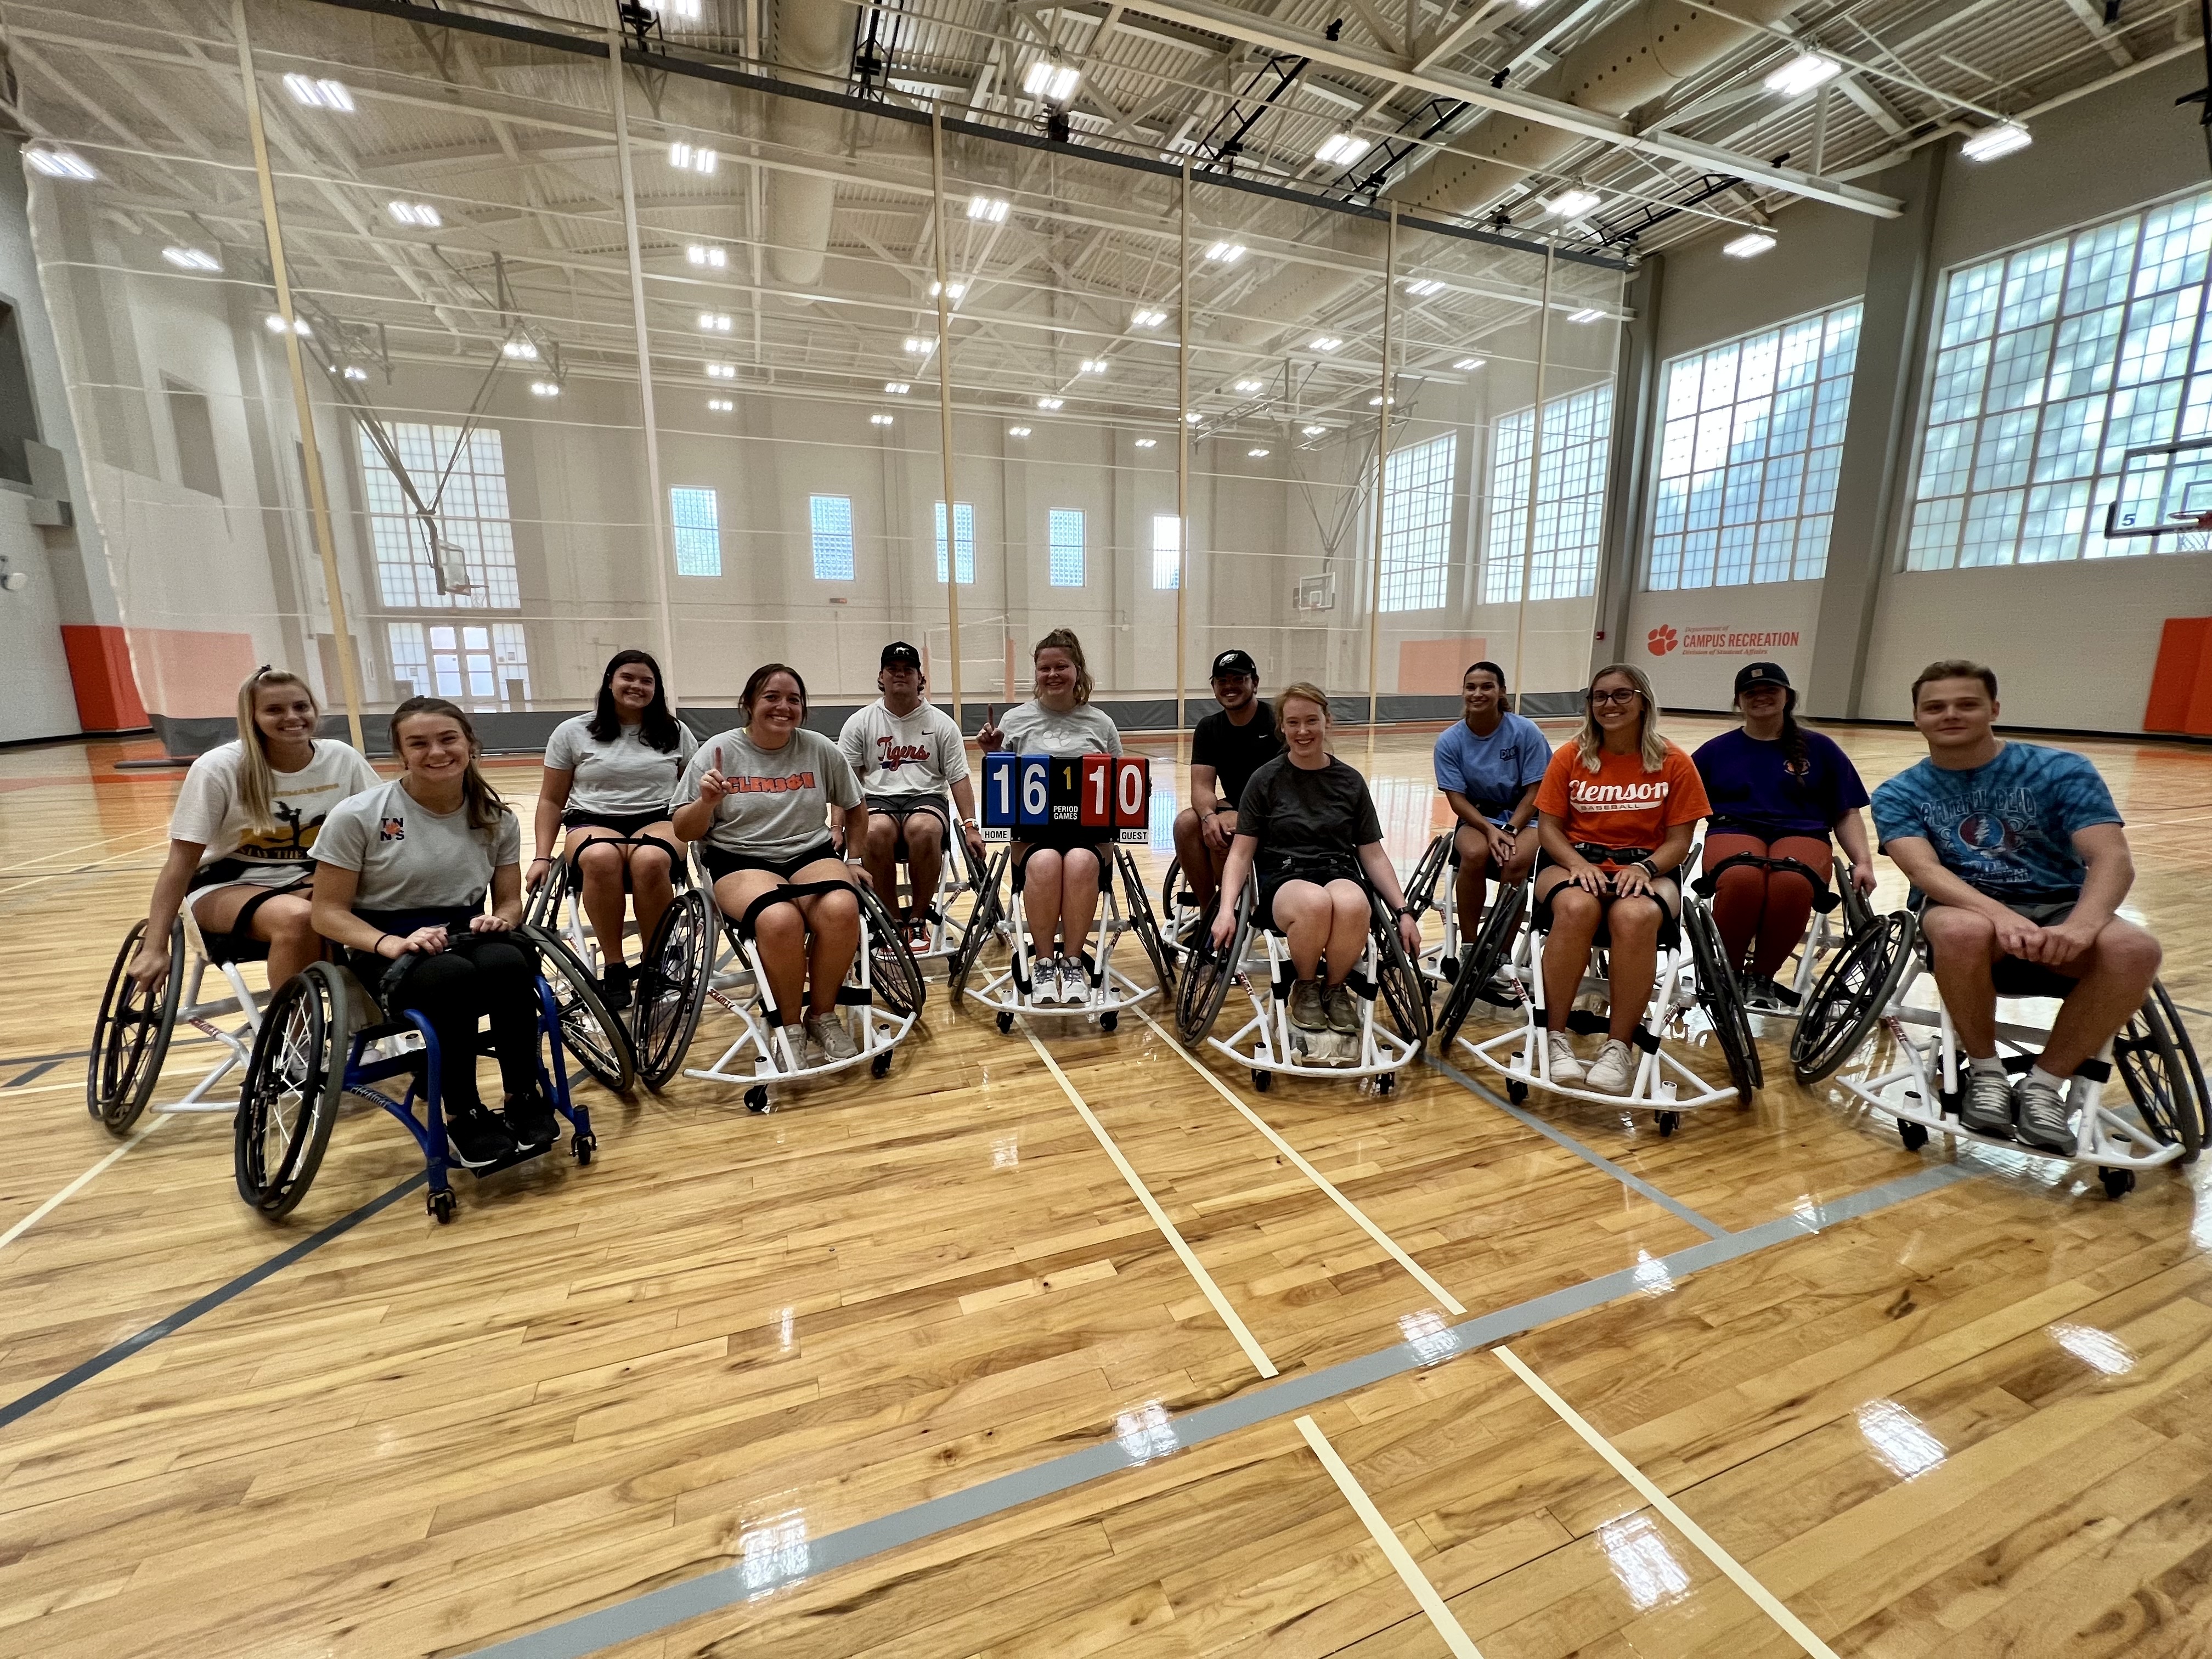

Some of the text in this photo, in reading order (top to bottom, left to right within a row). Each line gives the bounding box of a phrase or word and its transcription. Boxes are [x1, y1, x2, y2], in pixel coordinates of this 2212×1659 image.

[2121, 513, 2136, 526] 5
[1684, 631, 1799, 647] CAMPUS RECREATION
[877, 736, 930, 771] Tigers
[1063, 766, 1072, 790] 1
[993, 764, 1046, 815] 16
[1089, 764, 1143, 815] 10
[1568, 780, 1669, 802] Clemson
[984, 831, 1007, 839] HOME
[1121, 831, 1147, 840] GUEST
